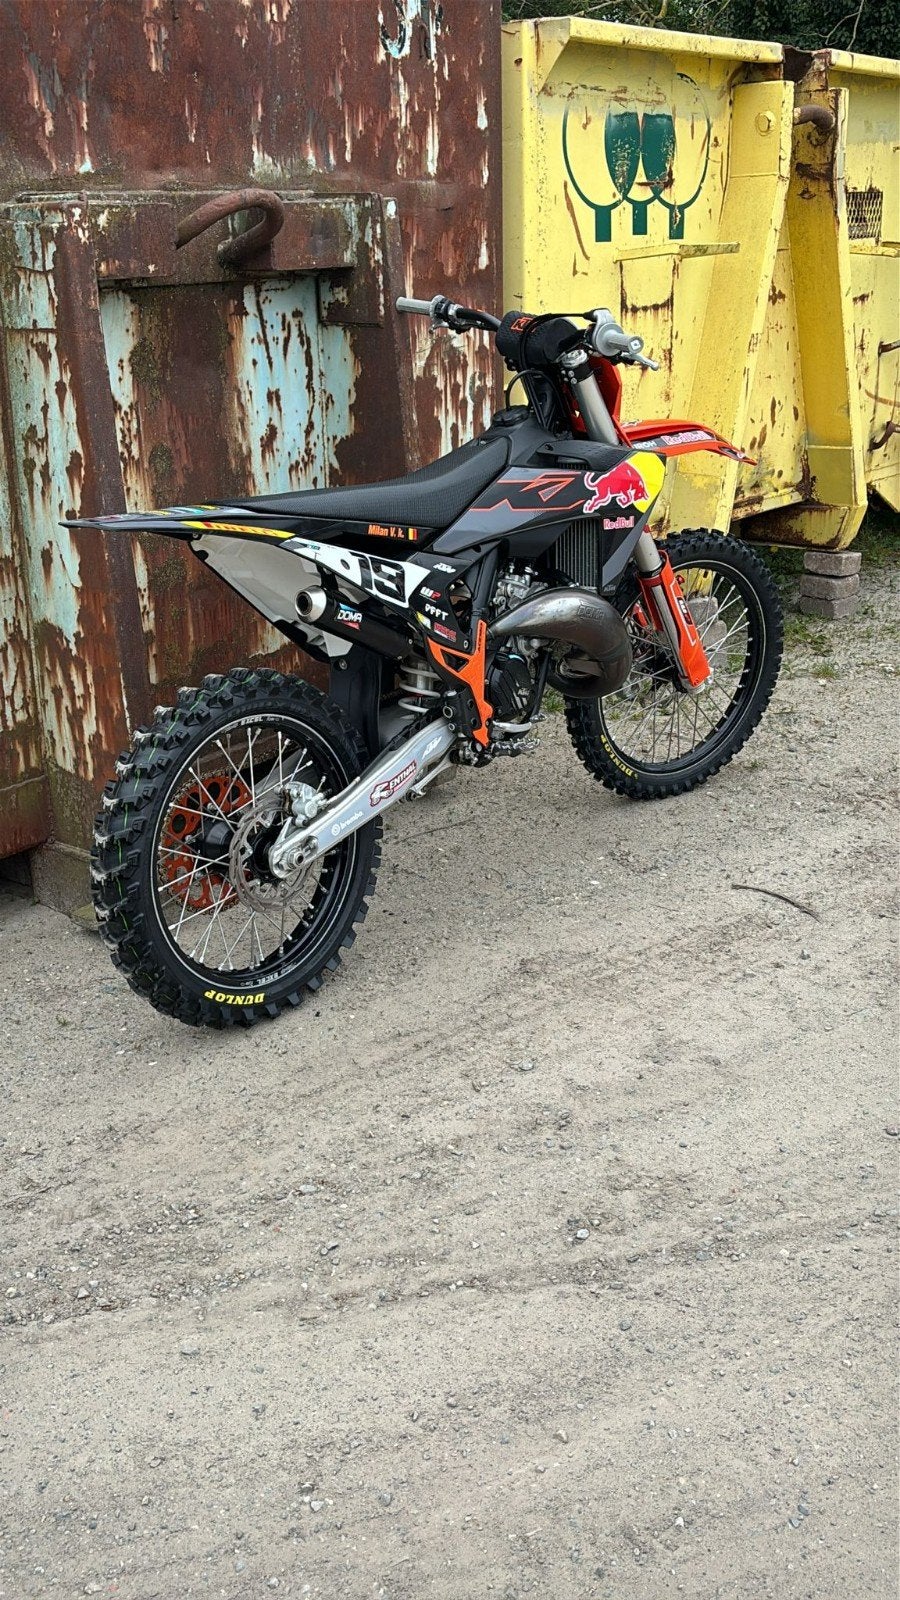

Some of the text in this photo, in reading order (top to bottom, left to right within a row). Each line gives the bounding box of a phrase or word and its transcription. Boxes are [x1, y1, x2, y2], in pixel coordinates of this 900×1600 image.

[368, 524, 389, 537] Milan
[390, 526, 397, 537] V.
[337, 610, 362, 622] DOMA
[204, 989, 265, 1005] DUNLOP
